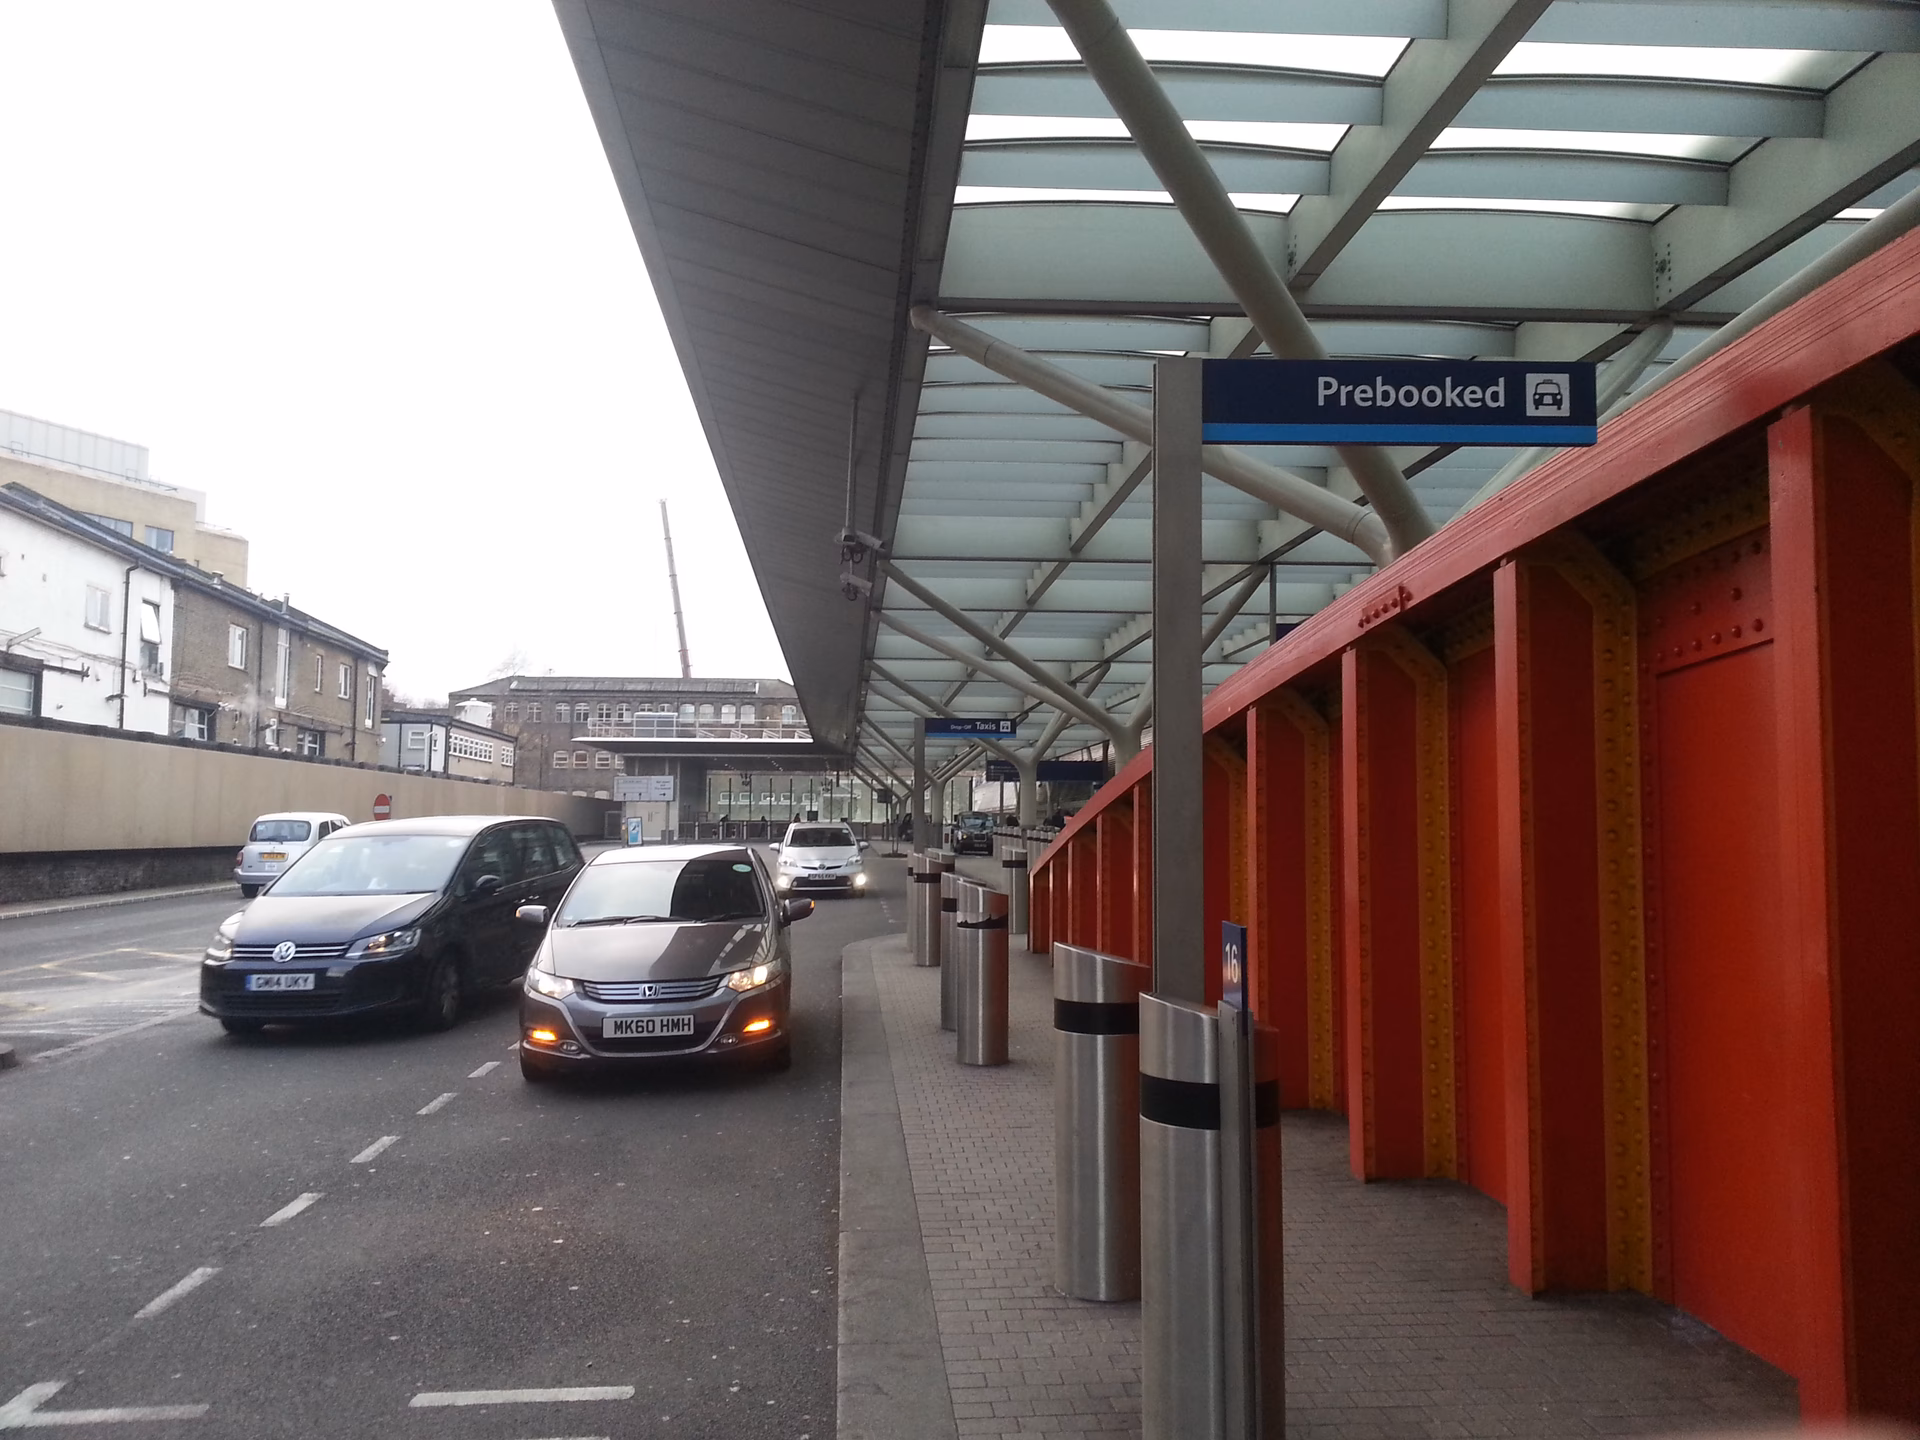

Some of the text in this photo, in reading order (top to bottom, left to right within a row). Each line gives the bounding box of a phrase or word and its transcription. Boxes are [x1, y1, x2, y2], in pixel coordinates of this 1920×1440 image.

[1317, 375, 1506, 408] Prebooked
[975, 721, 996, 730] Taxis
[1225, 942, 1239, 984] 16
[284, 975, 310, 988] UKY
[613, 1017, 691, 1035] MK60 HMH
